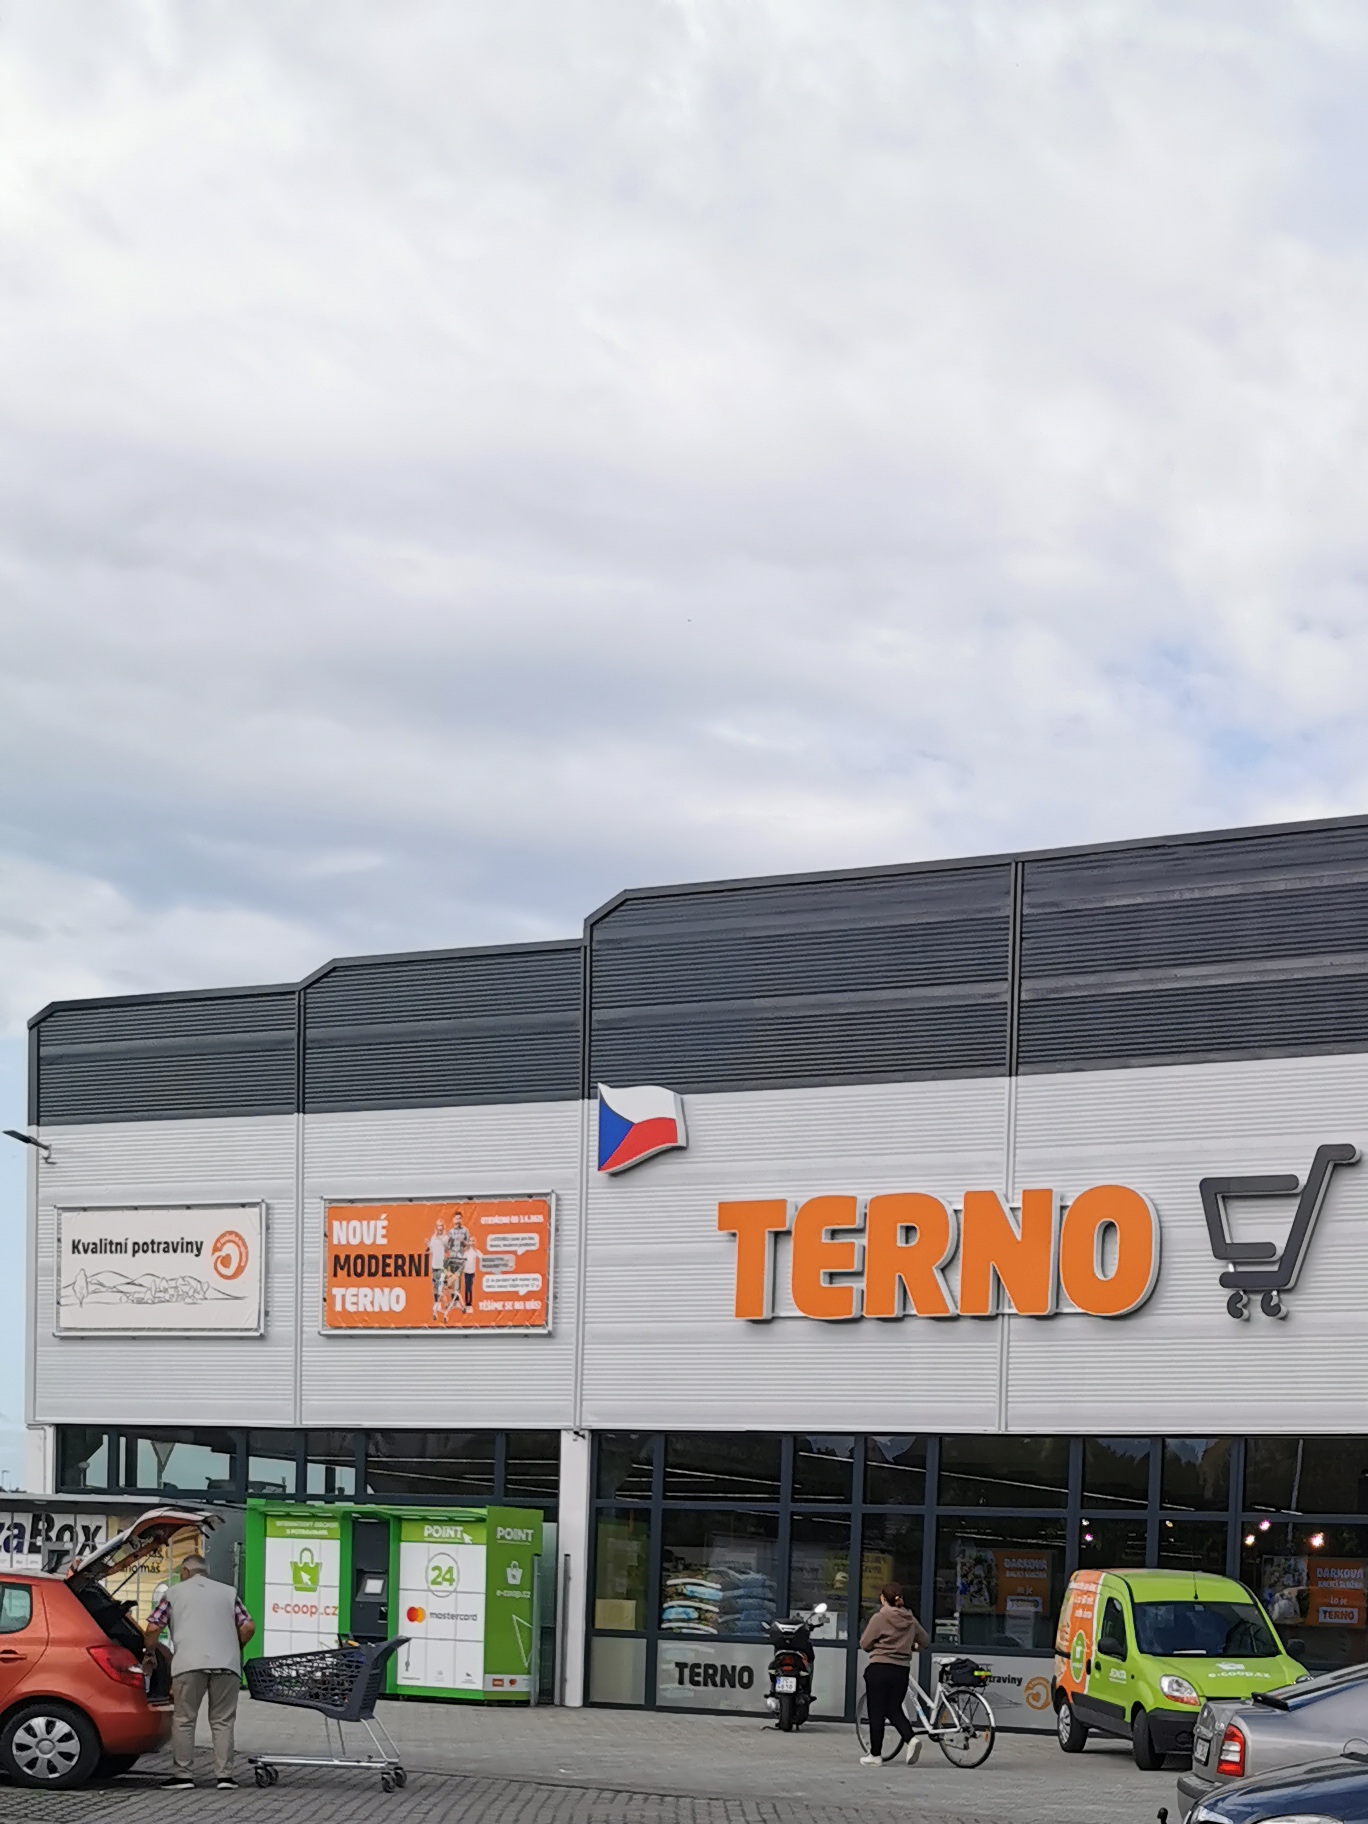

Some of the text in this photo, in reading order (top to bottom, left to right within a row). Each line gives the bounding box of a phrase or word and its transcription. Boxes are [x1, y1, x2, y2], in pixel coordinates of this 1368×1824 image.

[332, 1213, 388, 1246] NOVÉ
[71, 1238, 129, 1255] Kvalitní
[132, 1237, 204, 1258] potraviny
[718, 1185, 1159, 1320] TERNO
[332, 1251, 430, 1278] MODERNÍ
[331, 1287, 407, 1313] TERNO
[0, 1513, 102, 1557] aBox
[423, 1525, 464, 1538] POINT
[496, 1526, 534, 1541] POINT
[430, 1565, 456, 1586] 24
[271, 1602, 339, 1618] e-coop.cz
[429, 1610, 478, 1622] mastercard
[1322, 1610, 1355, 1620] TERNO
[675, 1662, 754, 1690] TERNO
